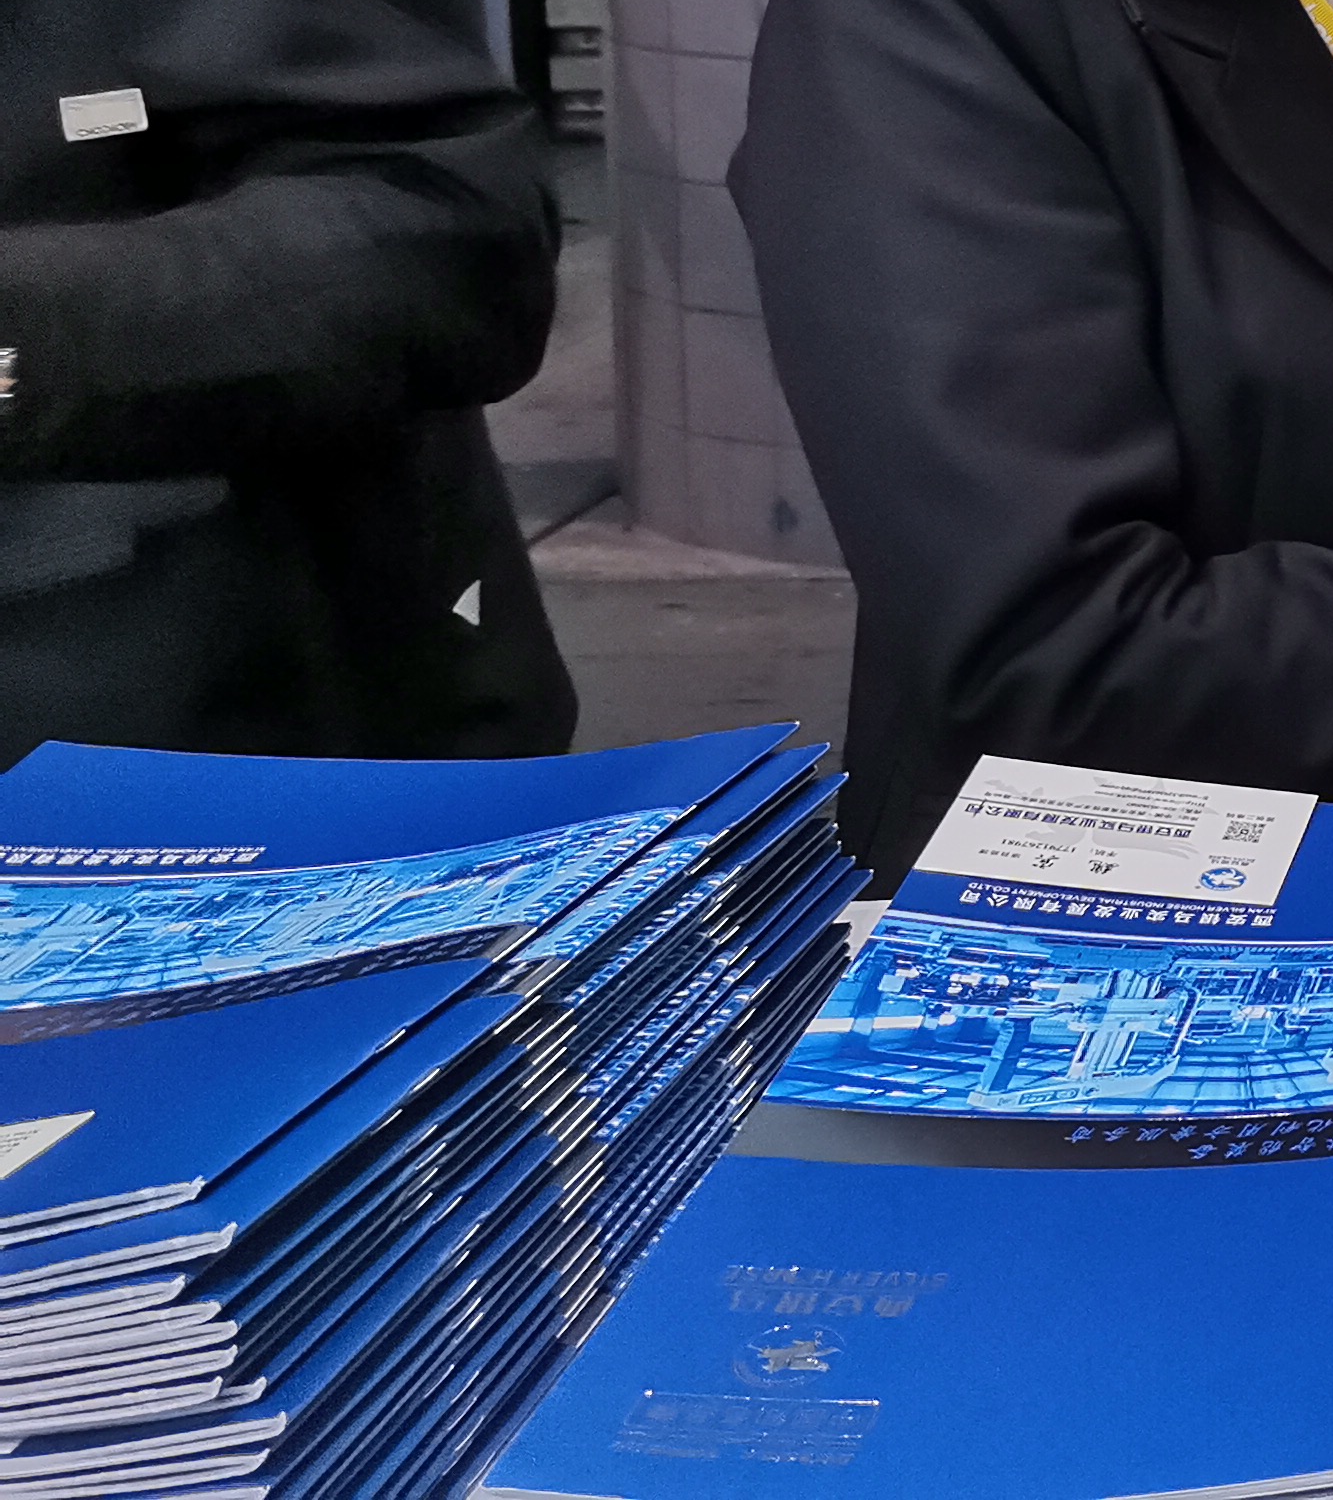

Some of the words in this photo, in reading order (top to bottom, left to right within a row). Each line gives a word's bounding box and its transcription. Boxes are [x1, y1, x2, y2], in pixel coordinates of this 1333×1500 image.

[964, 803, 1192, 839] 西安银马实业发展有限公司
[957, 889, 1275, 927] 西安银马实业发展有限公司
[1011, 888, 1096, 904] DEVELOPMENT
[1098, 895, 1166, 910] INDUSTRIAL
